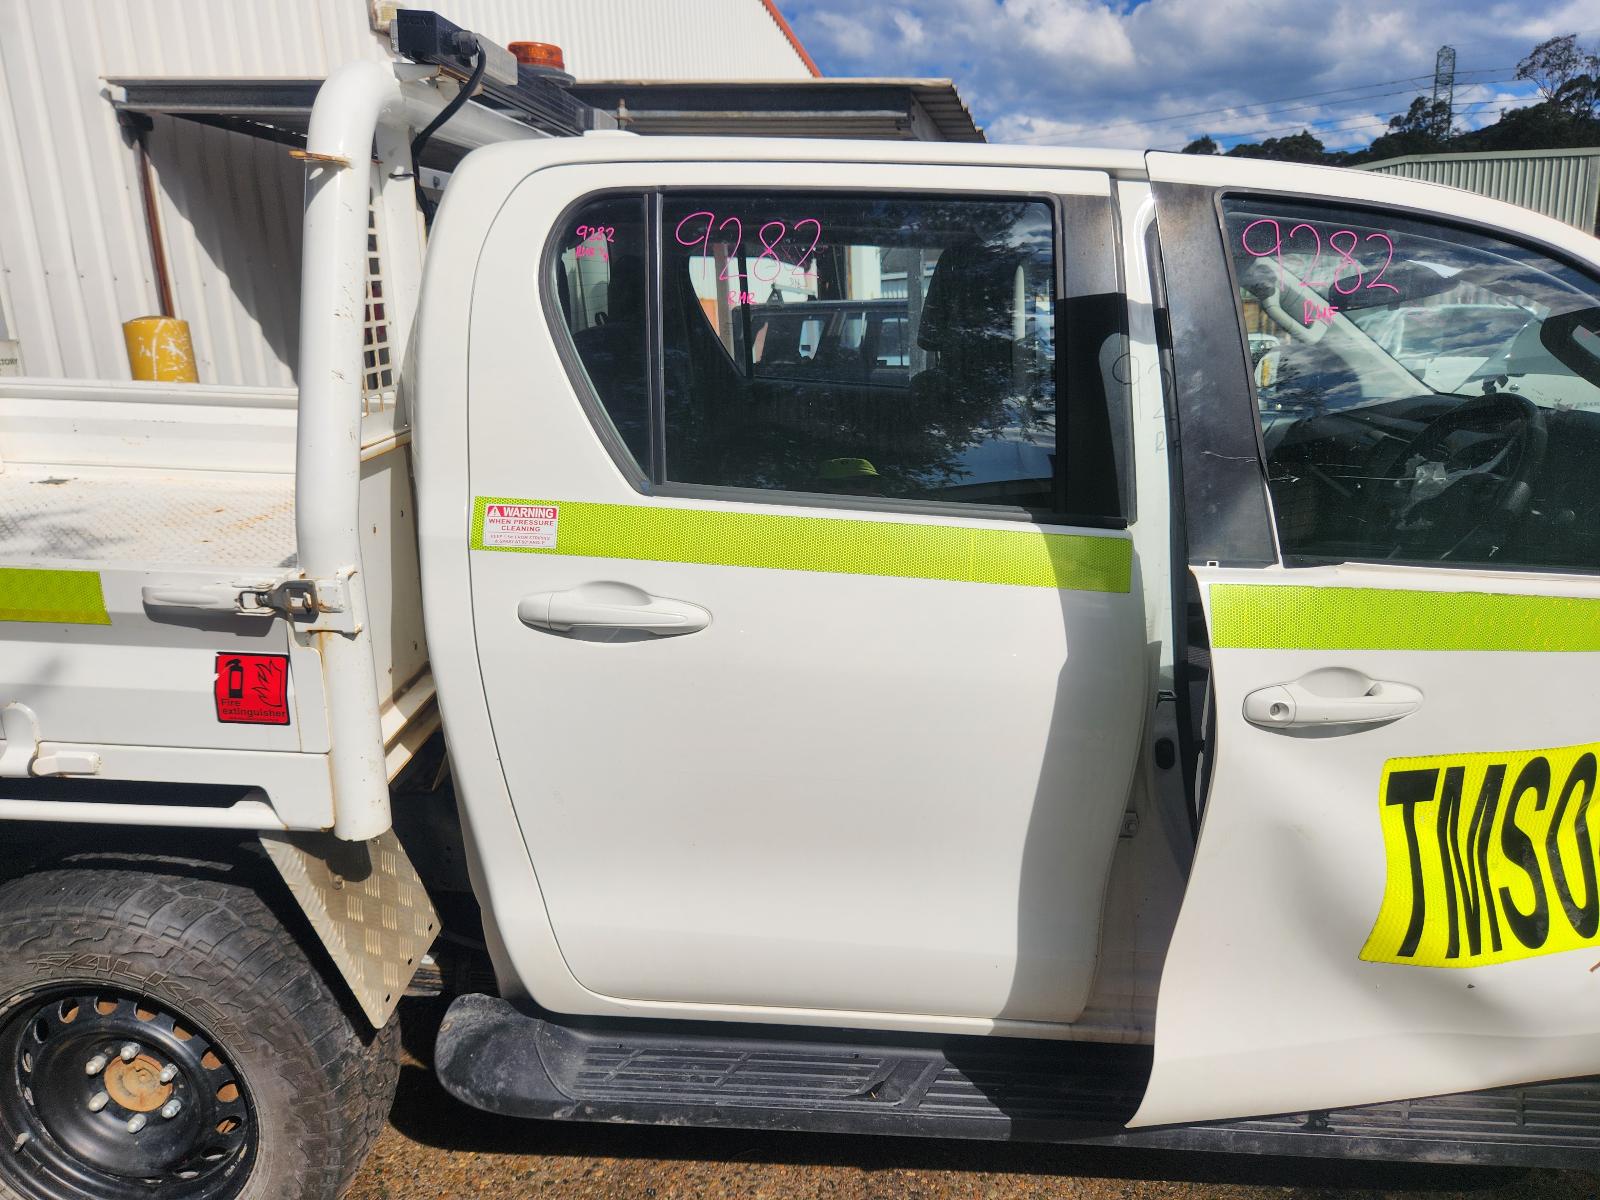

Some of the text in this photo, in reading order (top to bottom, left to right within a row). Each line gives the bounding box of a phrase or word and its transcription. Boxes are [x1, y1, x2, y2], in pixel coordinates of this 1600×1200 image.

[576, 225, 615, 242] 9282
[675, 211, 821, 281] 9282
[1242, 219, 1399, 295] 9282
[503, 507, 554, 518] WARNING
[513, 519, 555, 527] PRESSURE
[221, 698, 241, 706] Fire
[222, 708, 285, 718] extinguisher
